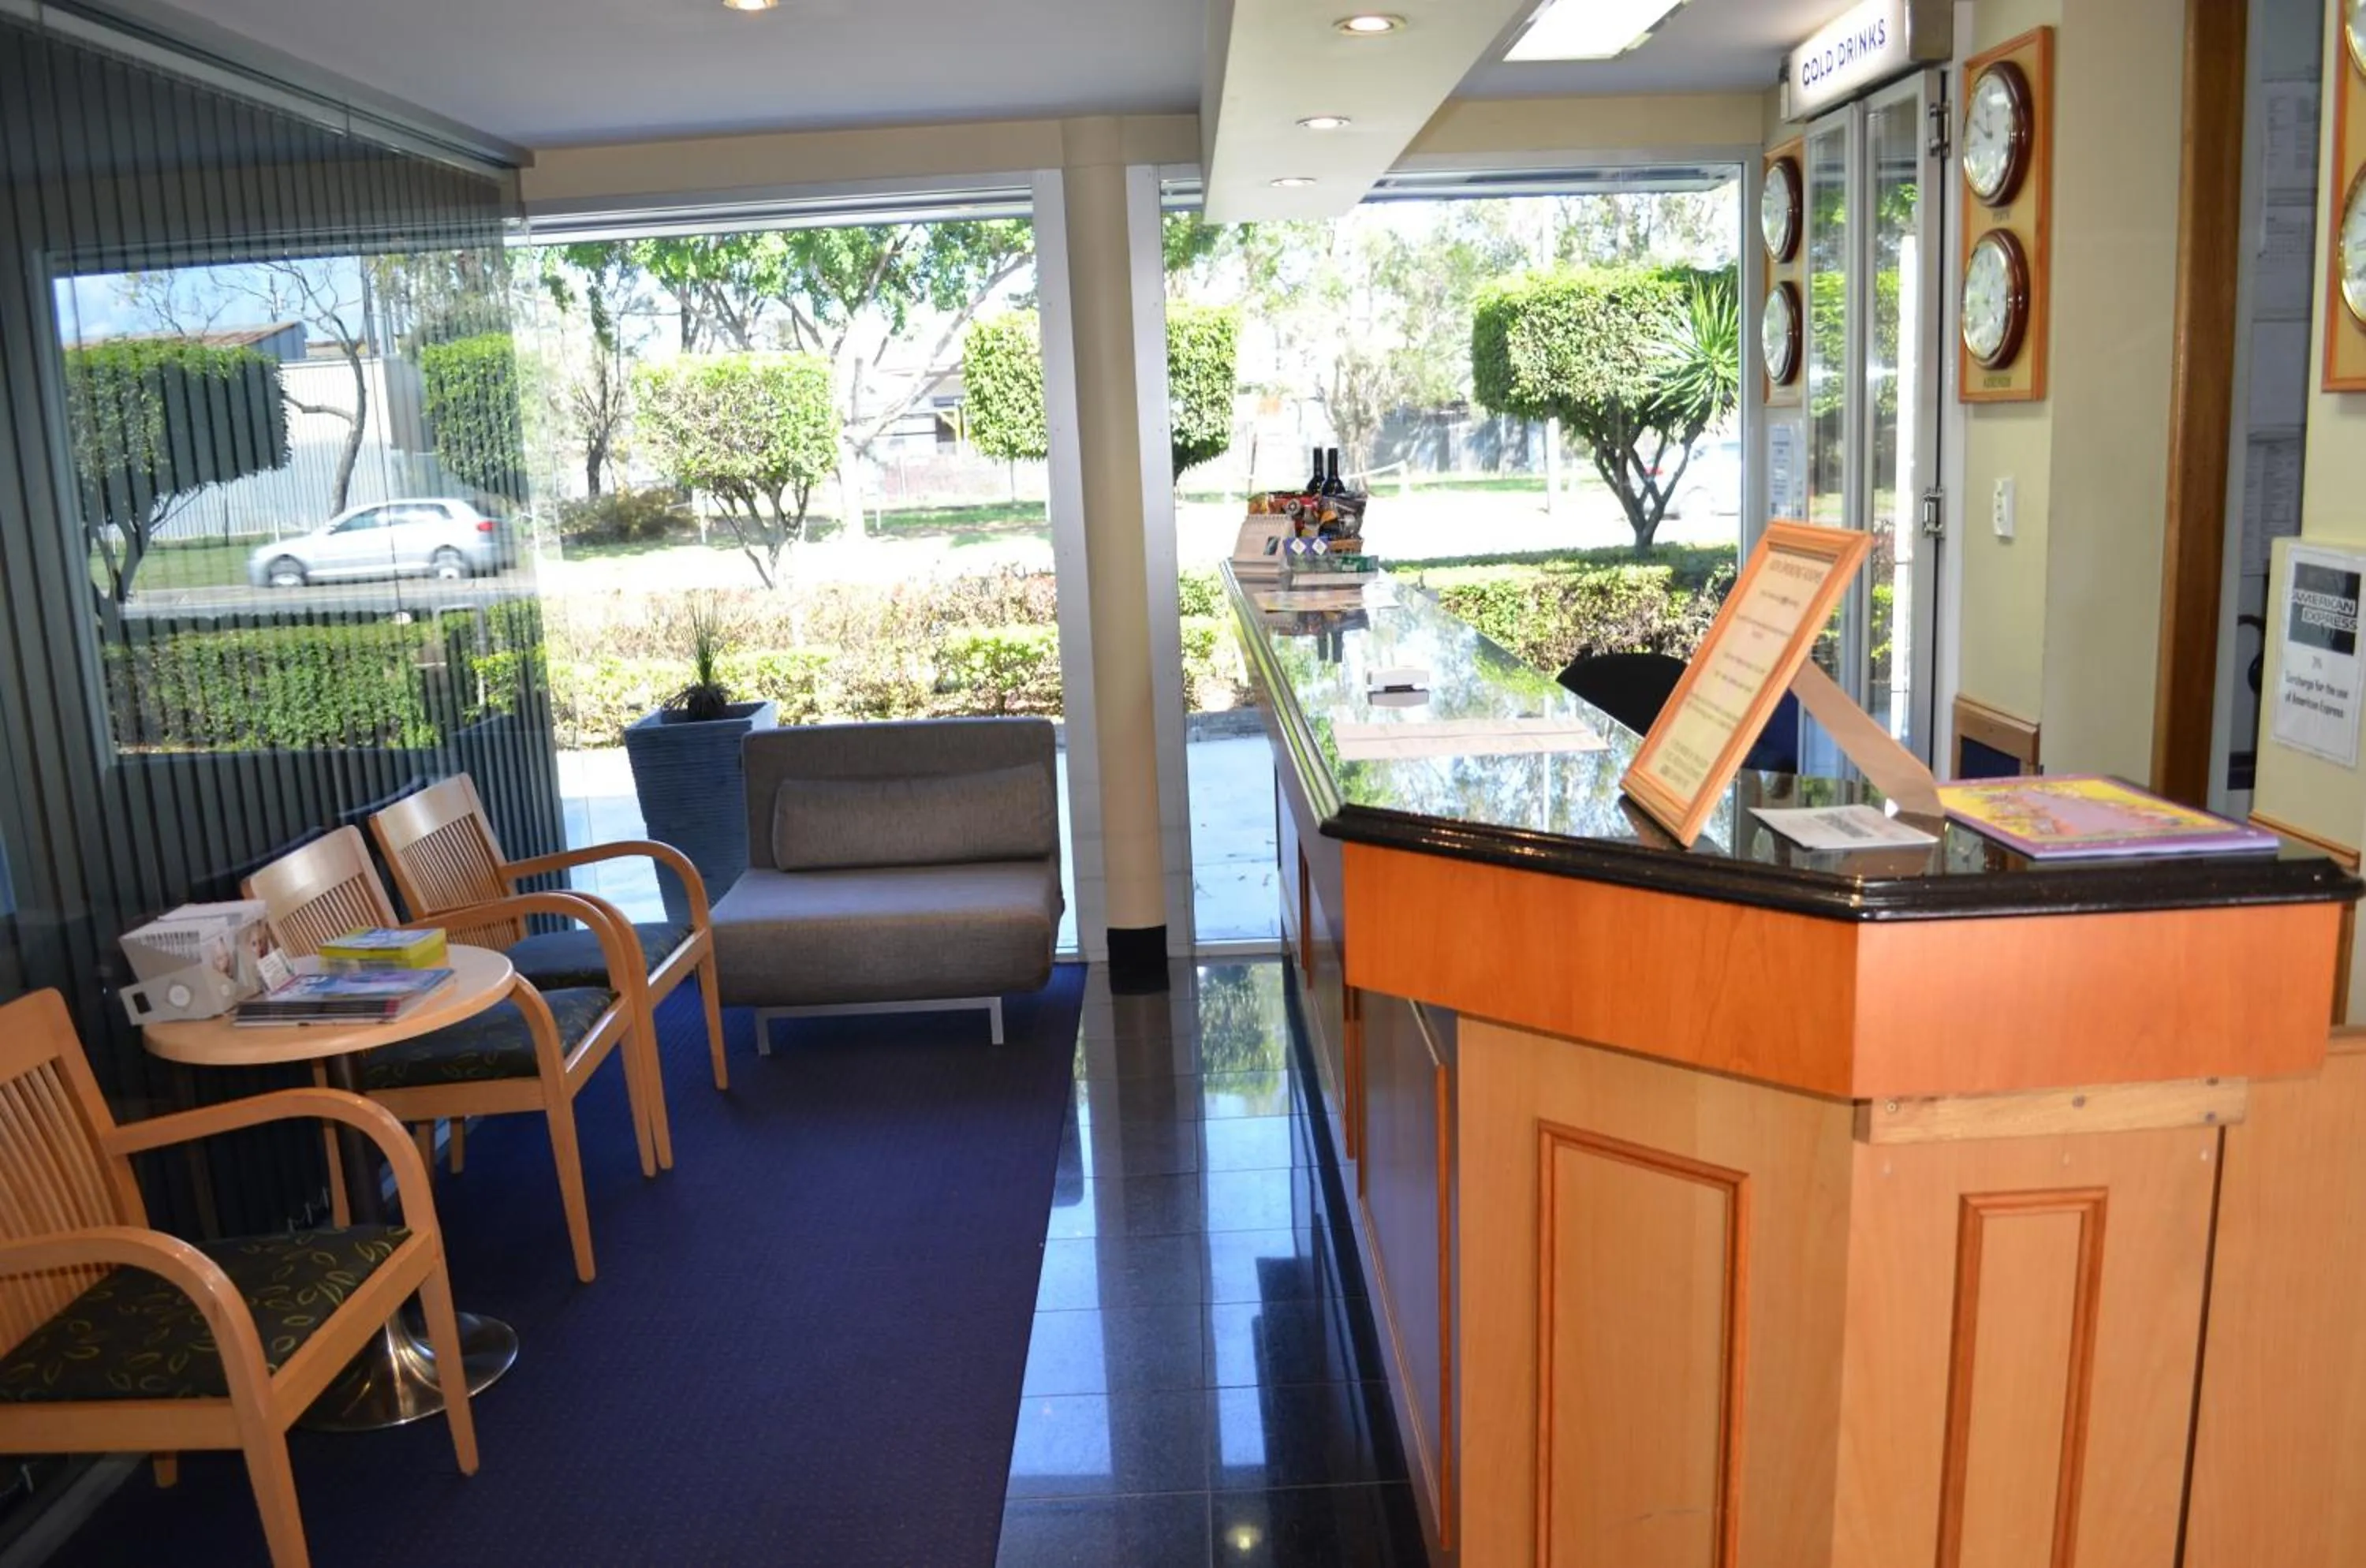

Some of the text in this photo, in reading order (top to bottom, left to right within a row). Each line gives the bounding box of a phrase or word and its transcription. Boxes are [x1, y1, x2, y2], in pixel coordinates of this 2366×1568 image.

[1802, 17, 1886, 86] COLD DRINKS
[2293, 589, 2354, 616] AMERICAN
[2302, 607, 2357, 632] EXPRESS
